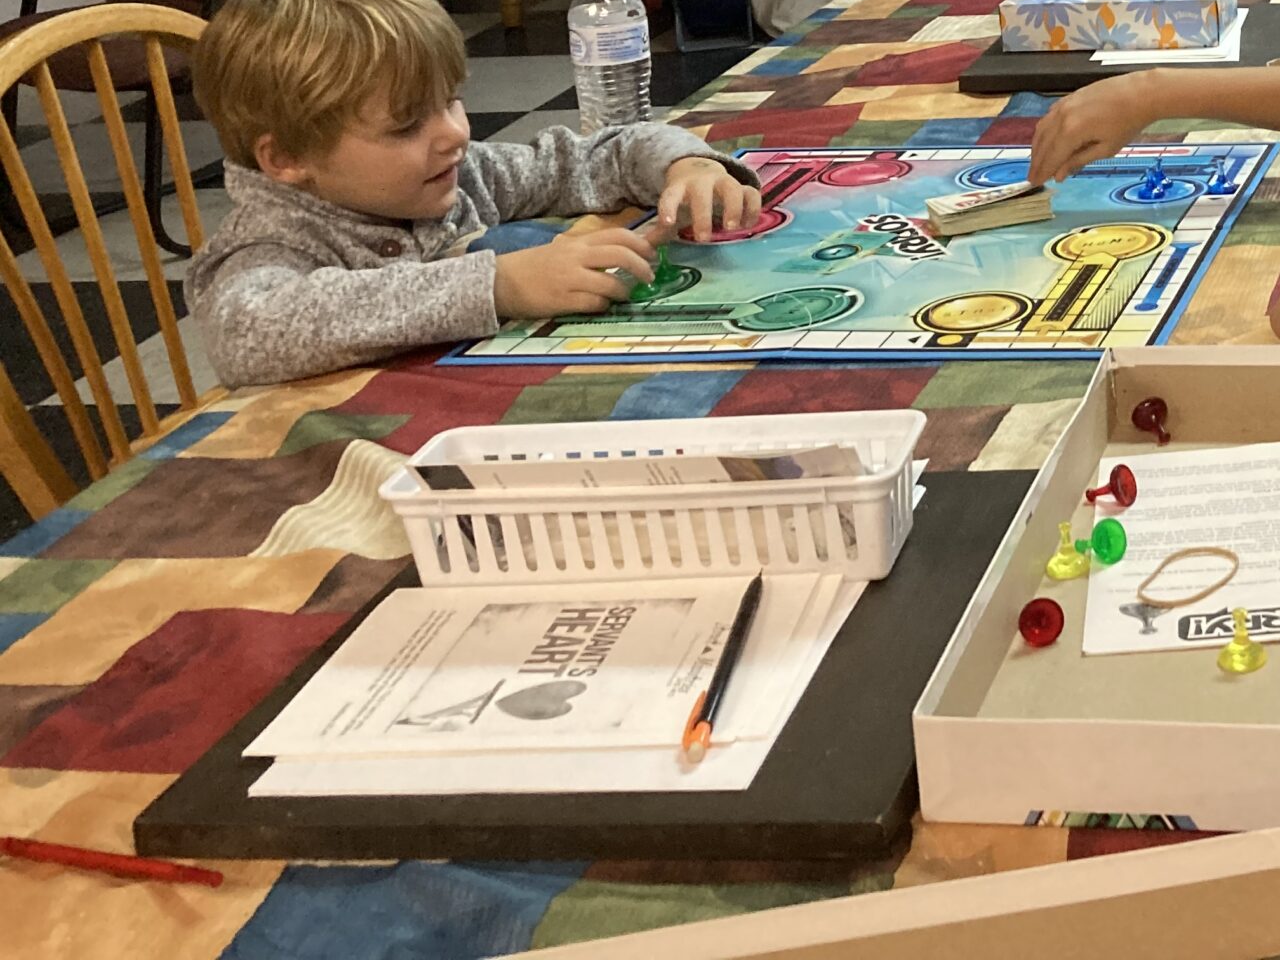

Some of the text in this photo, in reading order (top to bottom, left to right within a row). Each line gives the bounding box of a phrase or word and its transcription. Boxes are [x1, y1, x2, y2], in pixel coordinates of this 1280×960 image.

[863, 213, 945, 261] SORRY!
[517, 607, 606, 678] HEART
[567, 606, 637, 678] SERVANT'S
